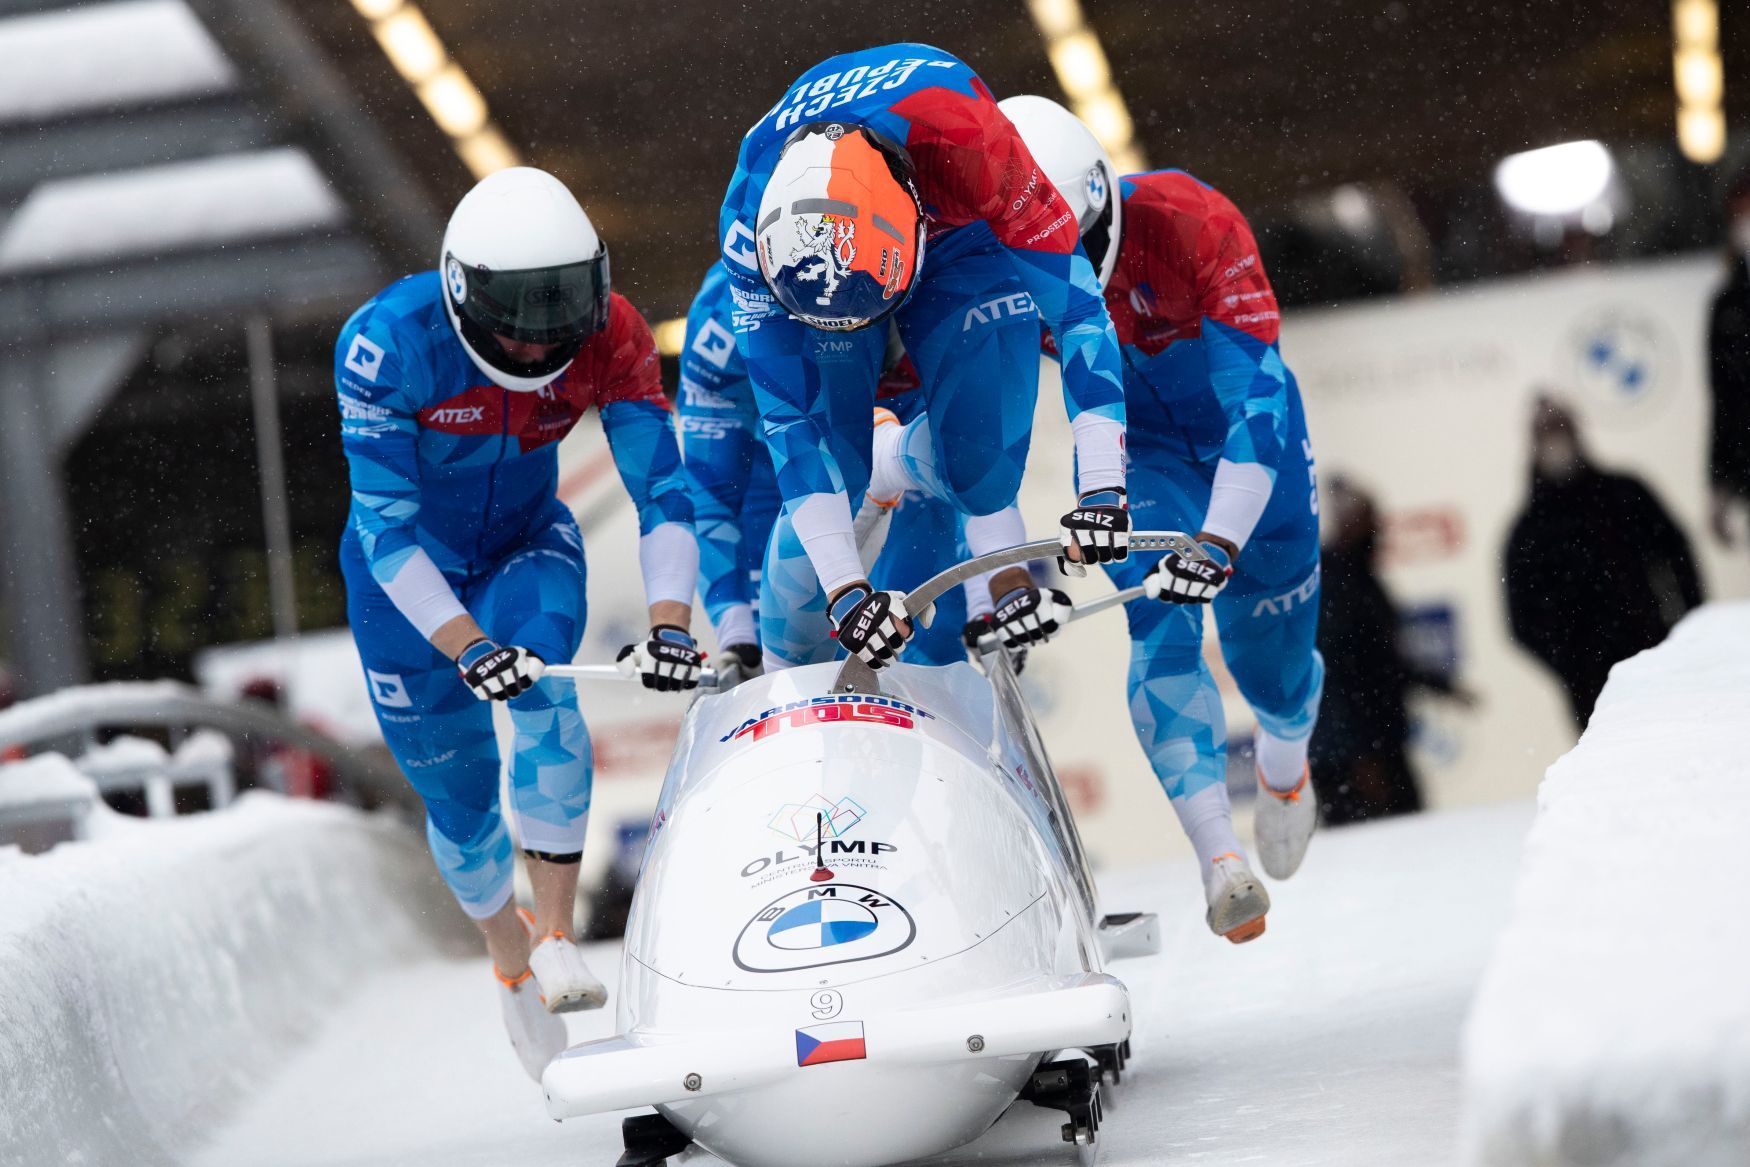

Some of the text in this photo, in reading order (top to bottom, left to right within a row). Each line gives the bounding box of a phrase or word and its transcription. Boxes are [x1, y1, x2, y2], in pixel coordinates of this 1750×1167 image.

[775, 66, 917, 131] CZECH
[1027, 211, 1072, 245] PROSEEDS
[815, 341, 853, 353] YMP
[428, 406, 485, 423] ATEX
[1071, 511, 1115, 527] SEIZ
[1176, 559, 1214, 580] SEIZ
[852, 600, 882, 641] SEIZ
[996, 595, 1031, 621] SEIZ
[476, 649, 512, 678] SEIZ
[659, 646, 697, 662] SEIZ
[719, 695, 936, 742] VARNSDORF
[734, 703, 914, 742] TOS
[740, 840, 898, 878] OLYMP
[751, 863, 839, 889] MINISTERSVA
[810, 989, 843, 1020] 9
